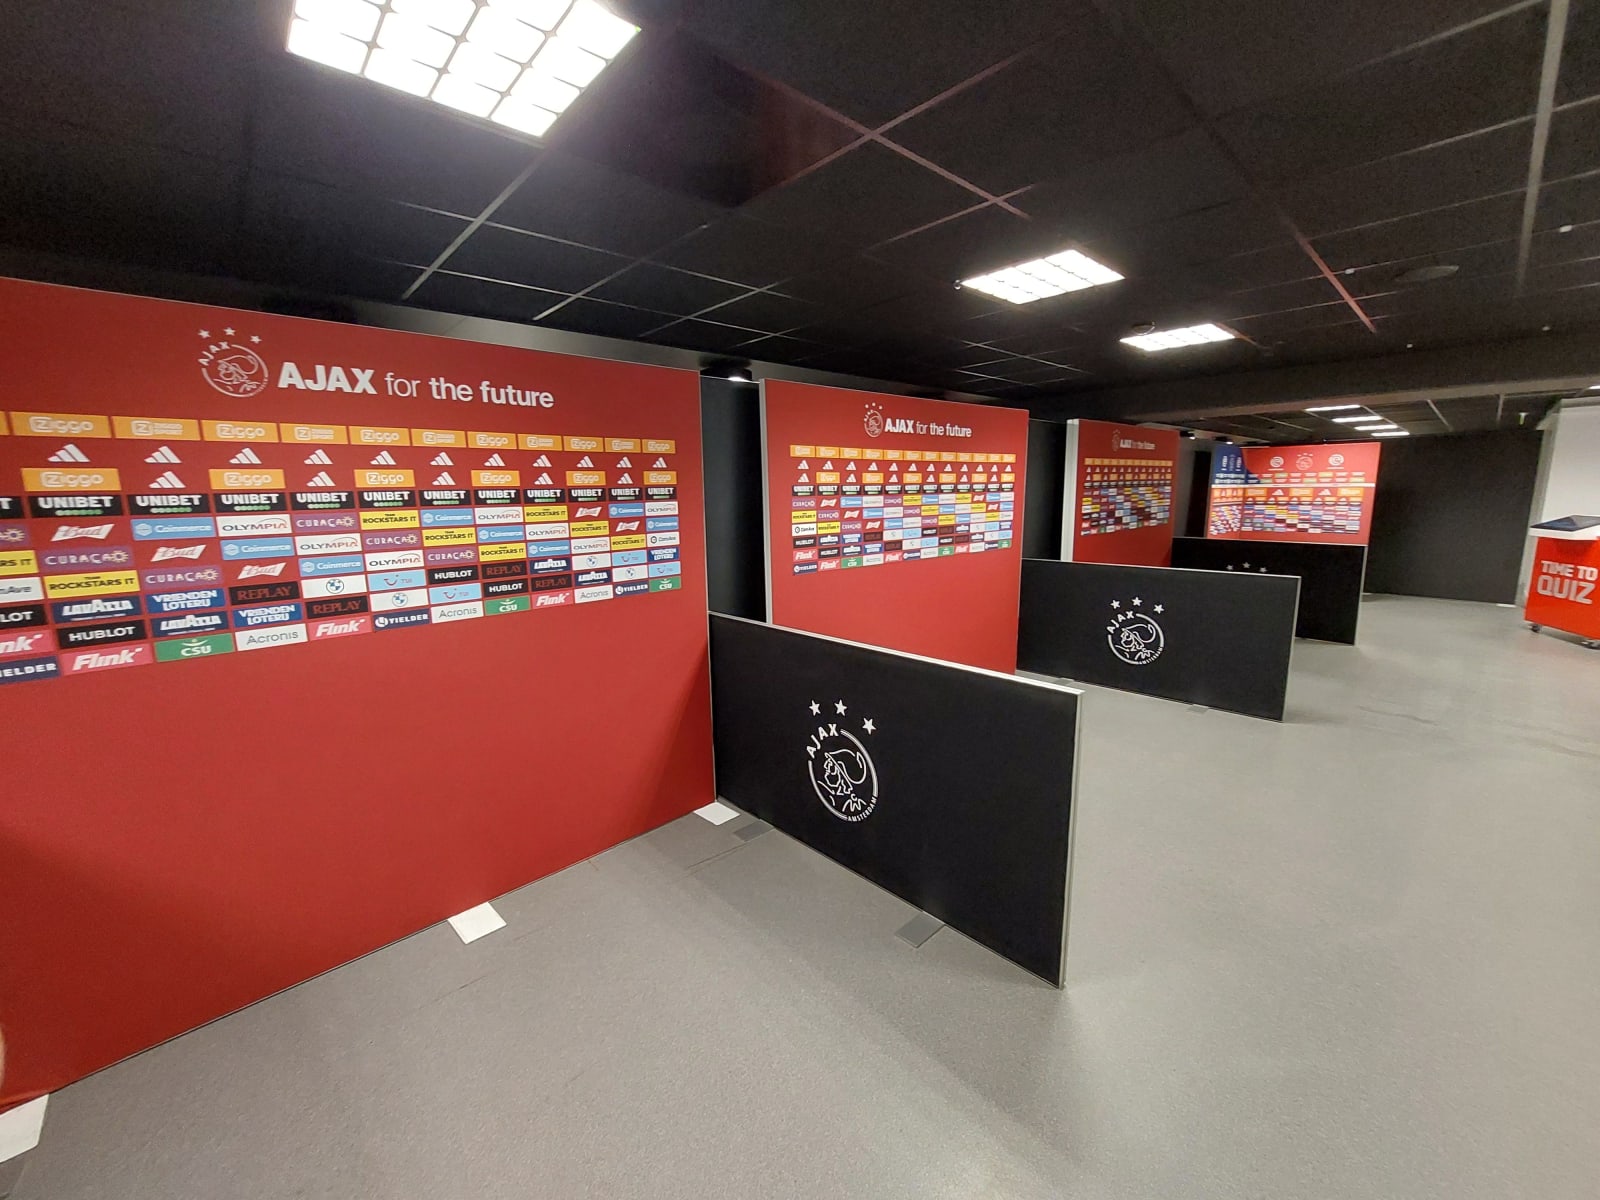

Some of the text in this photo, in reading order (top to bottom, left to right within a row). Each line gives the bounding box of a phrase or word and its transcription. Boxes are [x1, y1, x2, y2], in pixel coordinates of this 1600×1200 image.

[277, 362, 378, 394] AJAX
[384, 372, 421, 397] for
[428, 377, 473, 402] the
[480, 381, 554, 408] future
[29, 416, 93, 433] Ziggo
[885, 418, 972, 437] AJAX for the future
[216, 424, 265, 438] Ziggo
[360, 430, 399, 442] Ziggo
[41, 472, 103, 487] Ziggo
[224, 472, 272, 486] Ziggo
[366, 472, 404, 485] Ziggo
[135, 495, 202, 506] UNIBET
[221, 493, 279, 504] UNIBET
[296, 493, 348, 502] UNIBET
[363, 491, 410, 501] UNIBET
[423, 490, 466, 499] UNIBET
[478, 490, 516, 499] UNIBET
[38, 496, 113, 508] UNIBET
[222, 522, 287, 531] OLYMPIA
[300, 541, 358, 550] OLYMPIA
[369, 557, 421, 566] OLYMPIA
[435, 570, 472, 580] HUBLOT
[487, 565, 522, 575] REPLAY
[1541, 560, 1598, 581] TIME TO
[50, 579, 120, 590] ROCKSTARS
[489, 583, 523, 592] HUBLOT
[536, 579, 567, 588] REPLAY
[1537, 575, 1595, 604] QUIZ
[152, 590, 217, 602] VRIENDEN
[237, 586, 292, 600] REPLAY
[536, 593, 568, 606] Flink
[62, 599, 133, 616] LAVAZZA
[239, 605, 295, 617] VRIENDEN
[313, 601, 360, 614] REPLAY
[439, 608, 477, 618] Acronis
[0, 612, 33, 622] LOT
[160, 615, 222, 630] LAVAZZA
[389, 614, 428, 624] YIELDER
[1107, 611, 1134, 633] AJAX
[69, 626, 136, 642] HUBLOT
[316, 619, 364, 637] Flink
[247, 632, 298, 645] Acronis
[181, 646, 211, 656] CSU
[72, 648, 141, 671] Flink
[0, 663, 56, 678] IELDER
[807, 724, 839, 758] AJAX
[847, 796, 877, 822] AMSTERDAM
